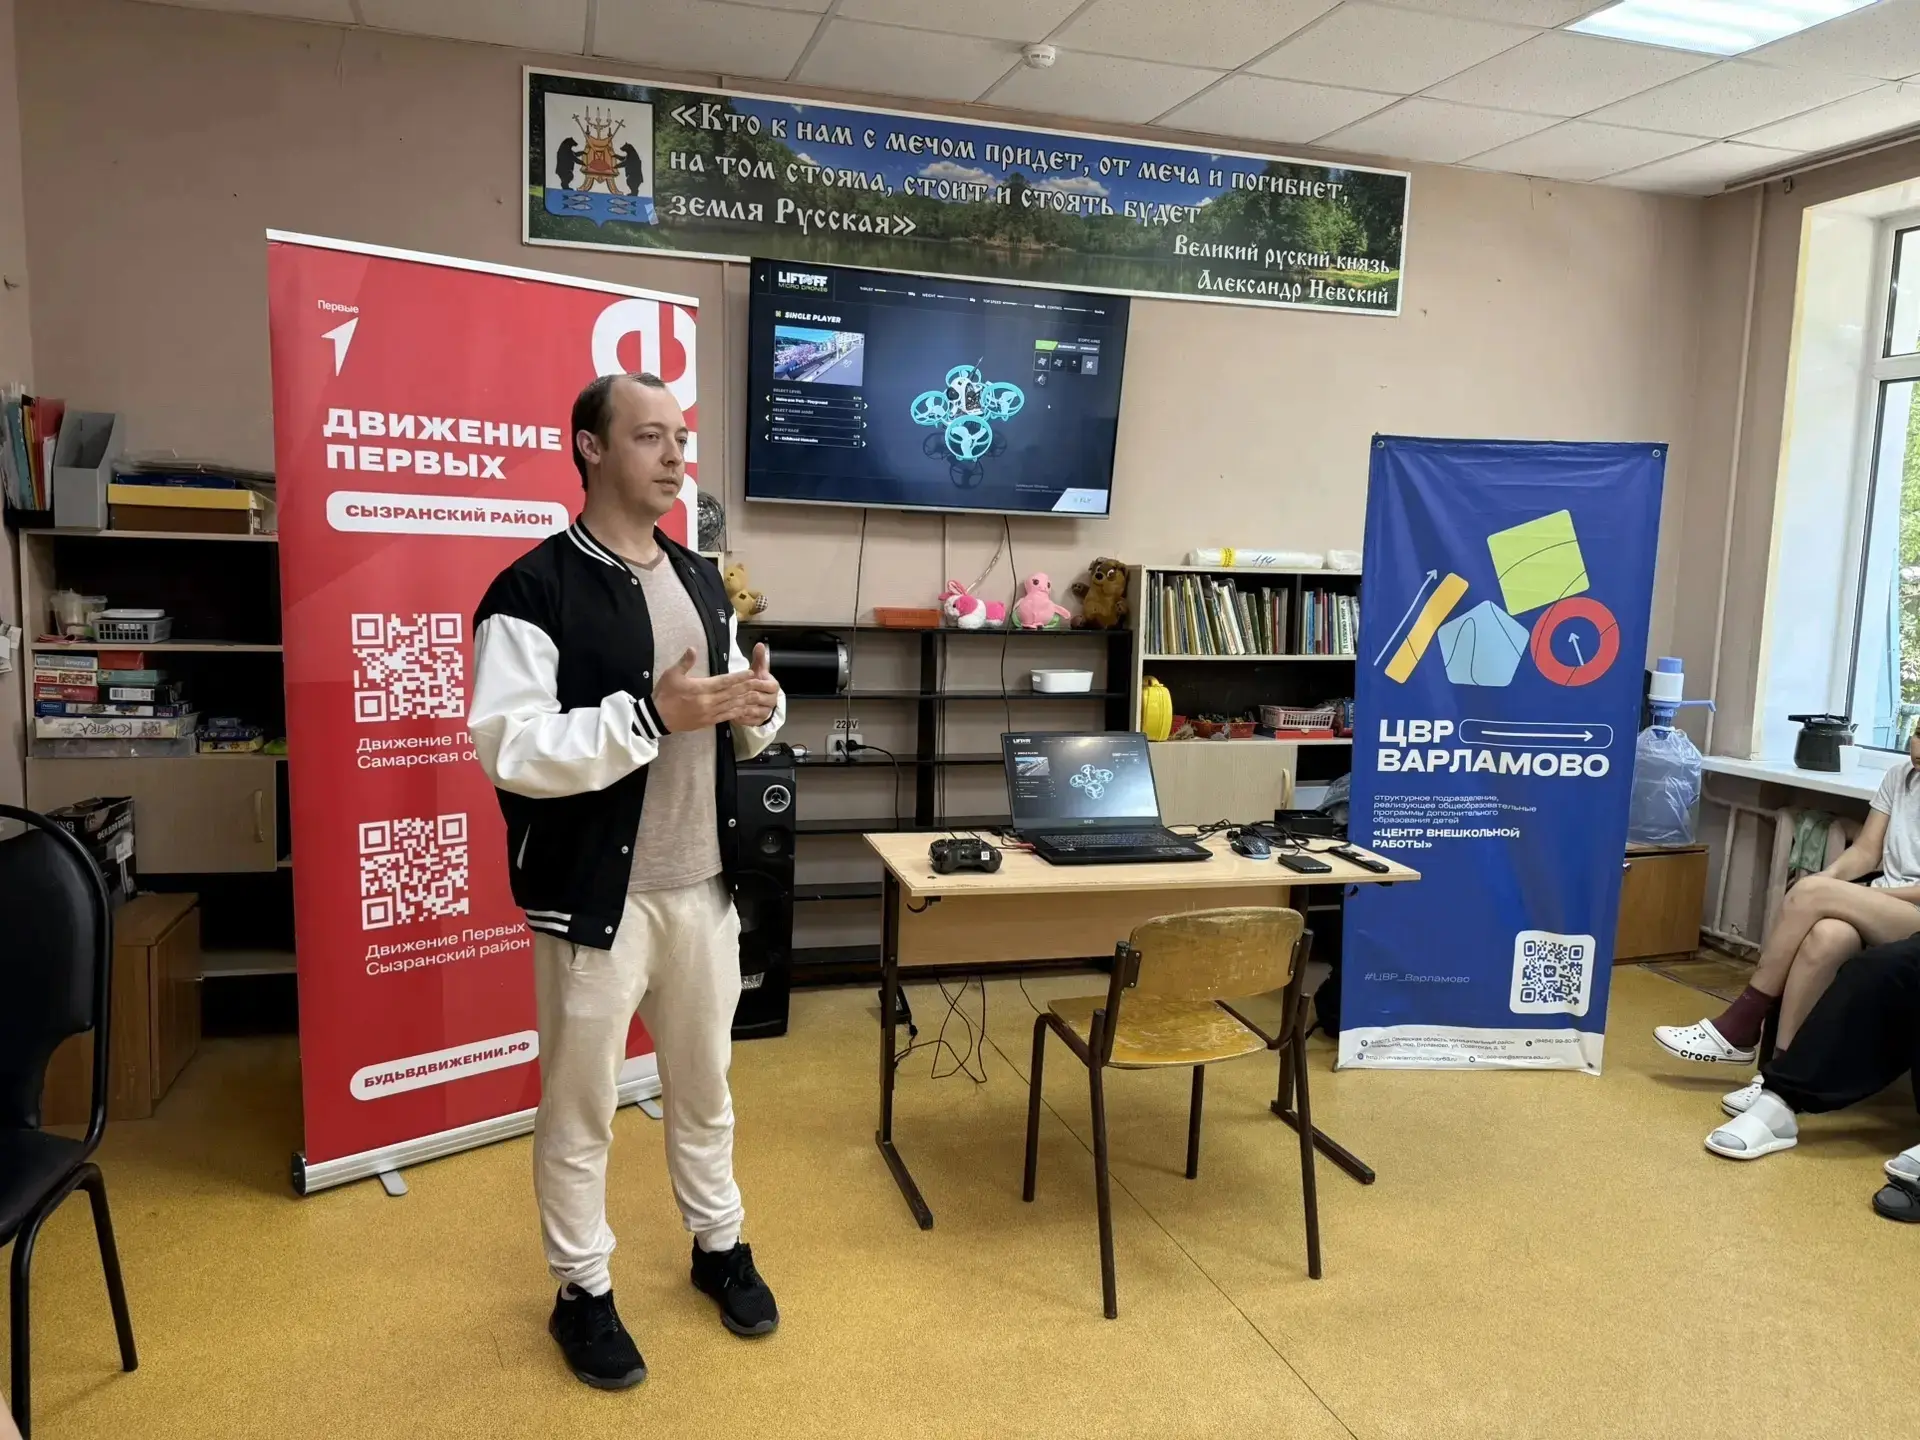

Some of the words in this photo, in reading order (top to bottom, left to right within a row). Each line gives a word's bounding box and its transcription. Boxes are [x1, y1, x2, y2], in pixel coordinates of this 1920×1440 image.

[771, 117, 787, 138] к
[797, 121, 853, 146] нам
[864, 128, 875, 149] с
[885, 131, 976, 160] мечом
[986, 143, 1090, 178] придет,
[1099, 156, 1131, 178] от
[1137, 161, 1200, 186] меча
[1209, 168, 1223, 188] и
[1231, 171, 1349, 203] погибнет,
[670, 150, 705, 173] на
[715, 155, 776, 180] том
[786, 162, 893, 195] стояла,
[904, 176, 989, 202] стоит
[997, 185, 1011, 206] и
[1021, 187, 1114, 217] стоять
[1124, 198, 1200, 228] будет
[669, 195, 763, 223] земля
[774, 197, 917, 238] Русская»
[1173, 233, 1259, 263] Великий
[1265, 247, 1331, 273] руский
[1336, 253, 1391, 275] князь
[778, 282, 800, 290] MICRO
[1197, 268, 1302, 301] Александр
[1308, 277, 1389, 305] Невский
[317, 299, 360, 315] Первые
[784, 311, 812, 321] SINGLE
[812, 314, 842, 324] PLAYER
[323, 407, 562, 452] ДВИЖЕНИЕ
[326, 444, 507, 480] ПЕРВЫХ
[345, 503, 486, 523] СЫЗРАНСКИЙ
[490, 508, 553, 526] РАЙОН
[836, 720, 858, 729] 220V
[1378, 719, 1454, 747] ЦВР
[356, 733, 452, 753] Движение
[357, 750, 459, 769] Самарская
[1377, 748, 1610, 778] ВАРЛАМОВО
[1373, 802, 1436, 810] реализующее
[1438, 801, 1538, 813] общеобразовательные
[1374, 794, 1431, 803] структурное
[1432, 794, 1500, 803] подразделение,
[1372, 816, 1431, 825] образования
[1432, 817, 1460, 825] детей
[1373, 809, 1424, 818] программы
[1426, 809, 1499, 818] дополнительного
[1372, 828, 1424, 838] «ЦЕНТР
[1426, 826, 1521, 839] ВНЕШКОЛЬНОЙ
[1372, 839, 1433, 849] РАБОТЫ»
[364, 934, 459, 962] Движение
[462, 922, 526, 944] Первых
[365, 945, 477, 976] Сызранский
[479, 937, 531, 959] район
[364, 1041, 530, 1088] БУДЬВДВИЖЕНИИ.РФ
[1680, 1050, 1717, 1062] crocs
